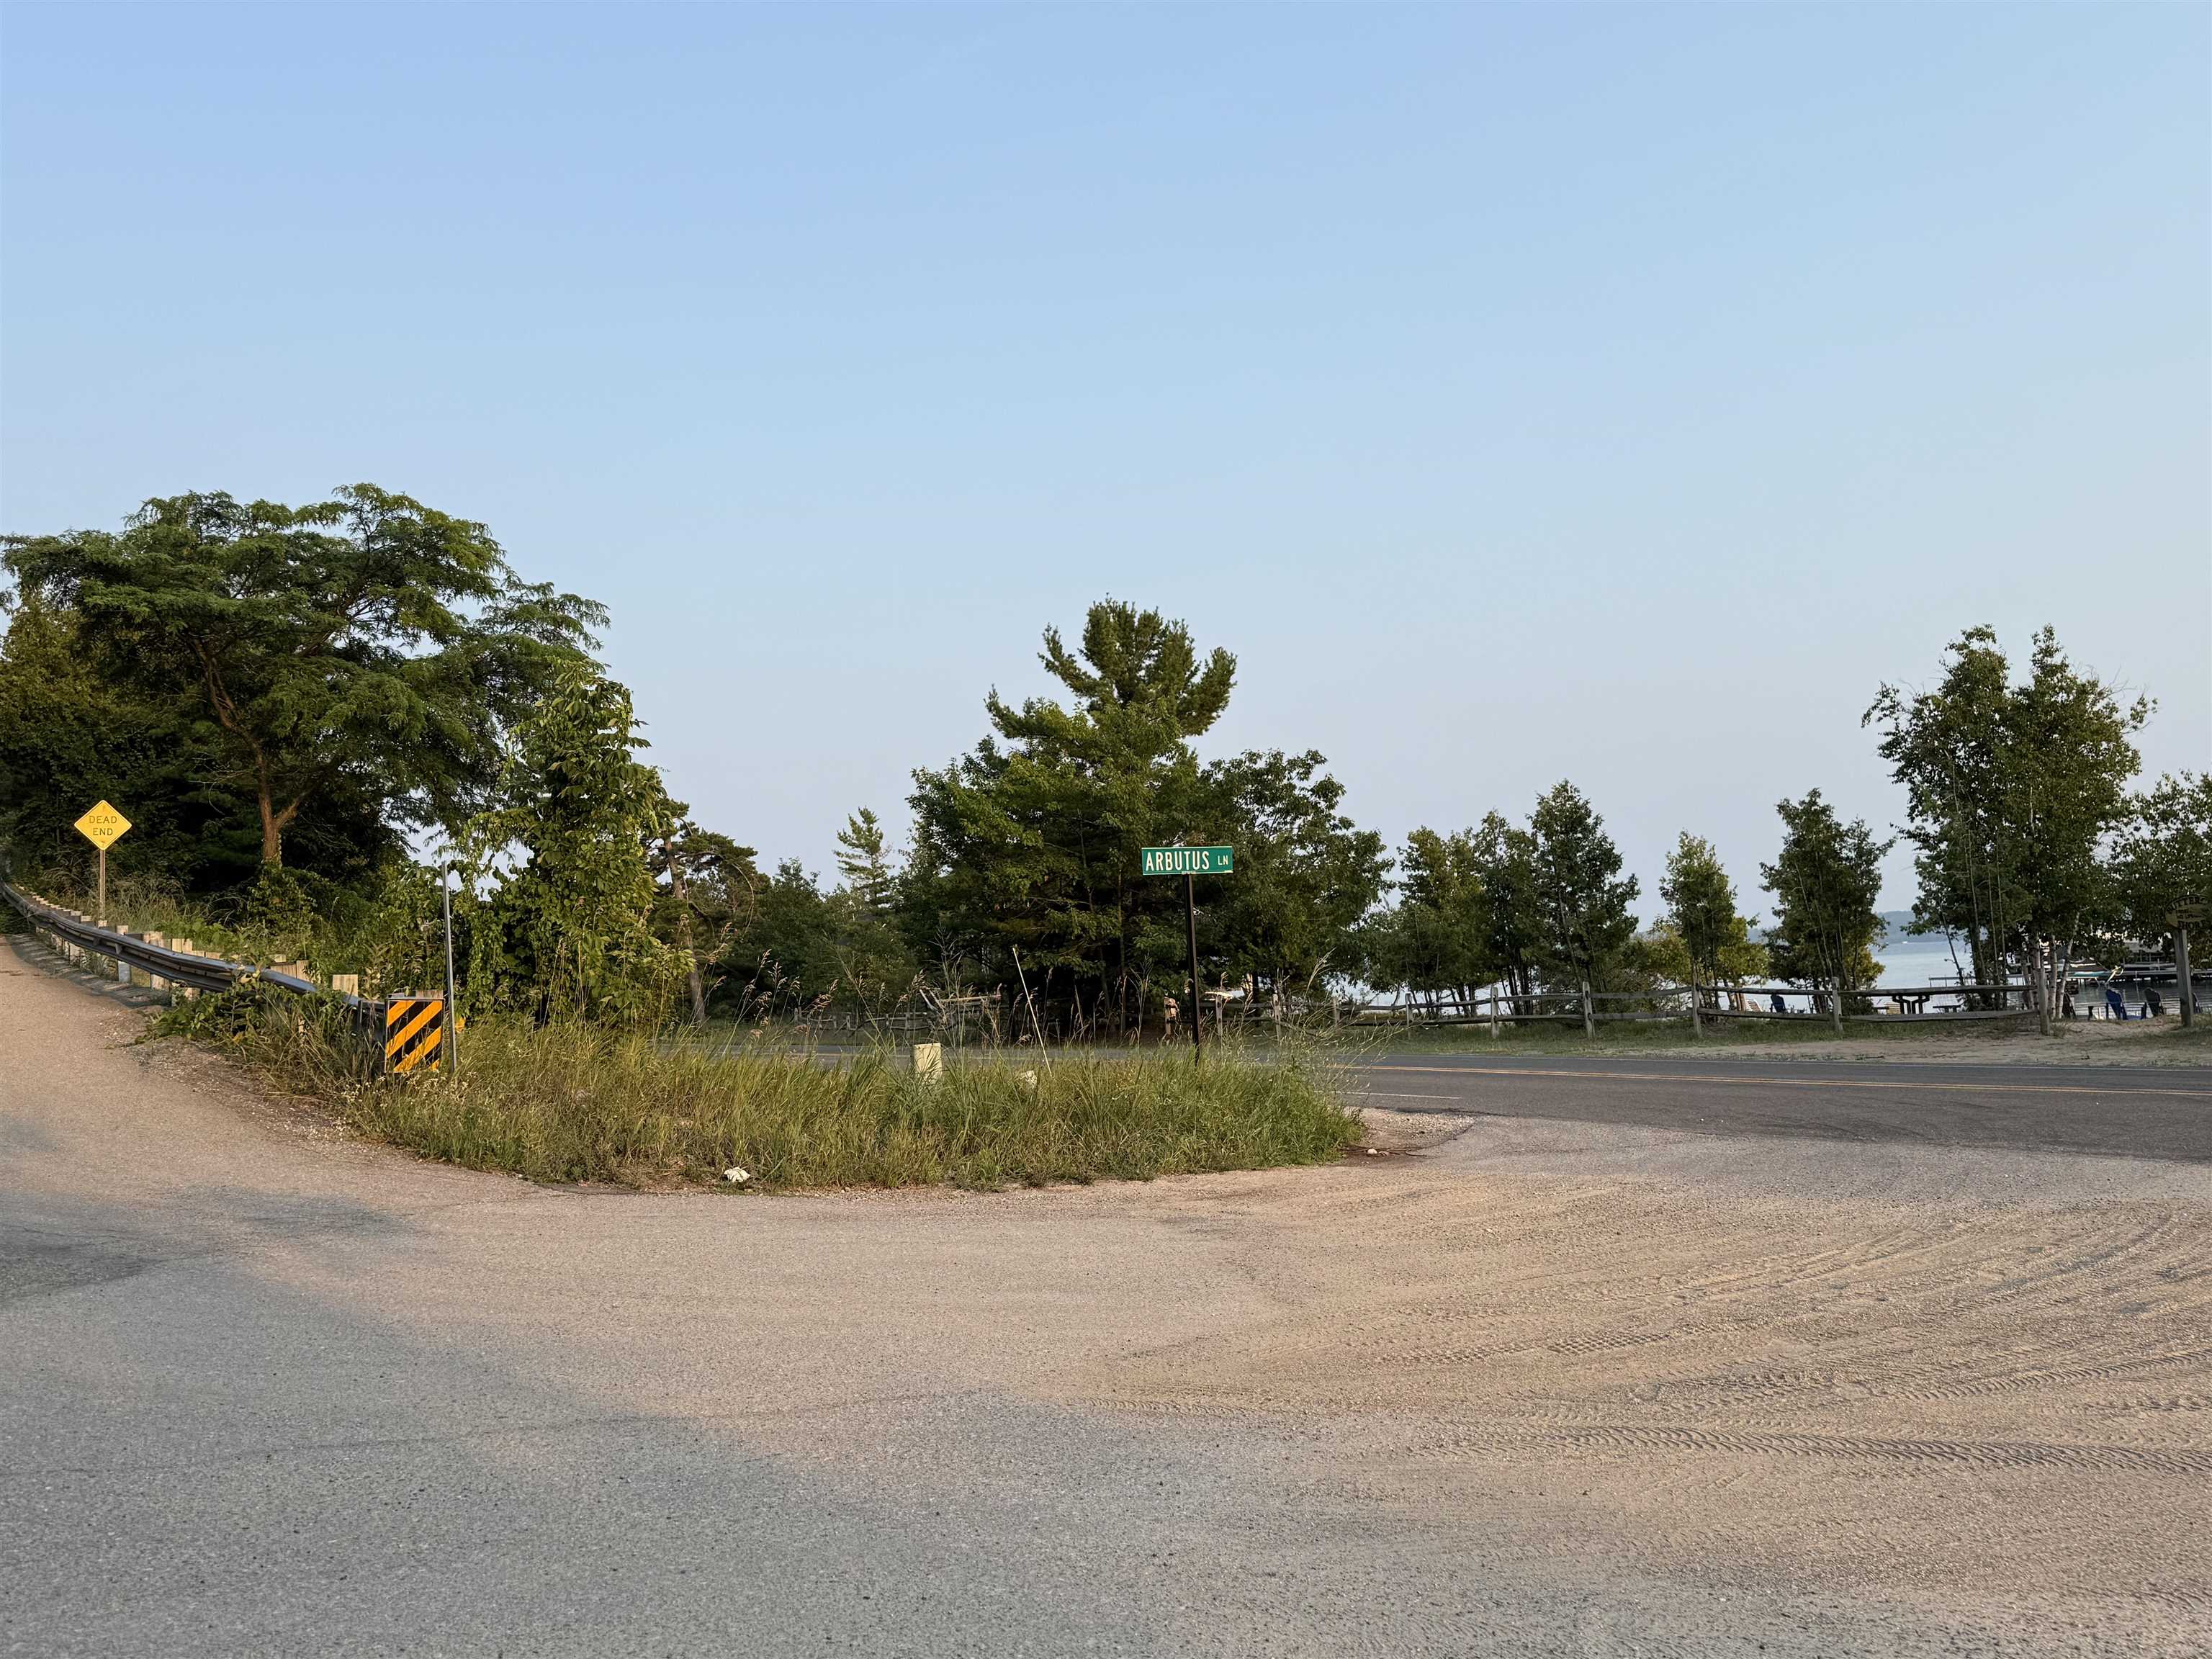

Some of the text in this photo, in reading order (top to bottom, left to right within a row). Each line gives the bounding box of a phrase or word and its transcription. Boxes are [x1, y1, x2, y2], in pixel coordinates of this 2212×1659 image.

[89, 815, 117, 824] DEAD
[92, 827, 113, 836] END
[1146, 850, 1228, 871] ARBUTUS LN
